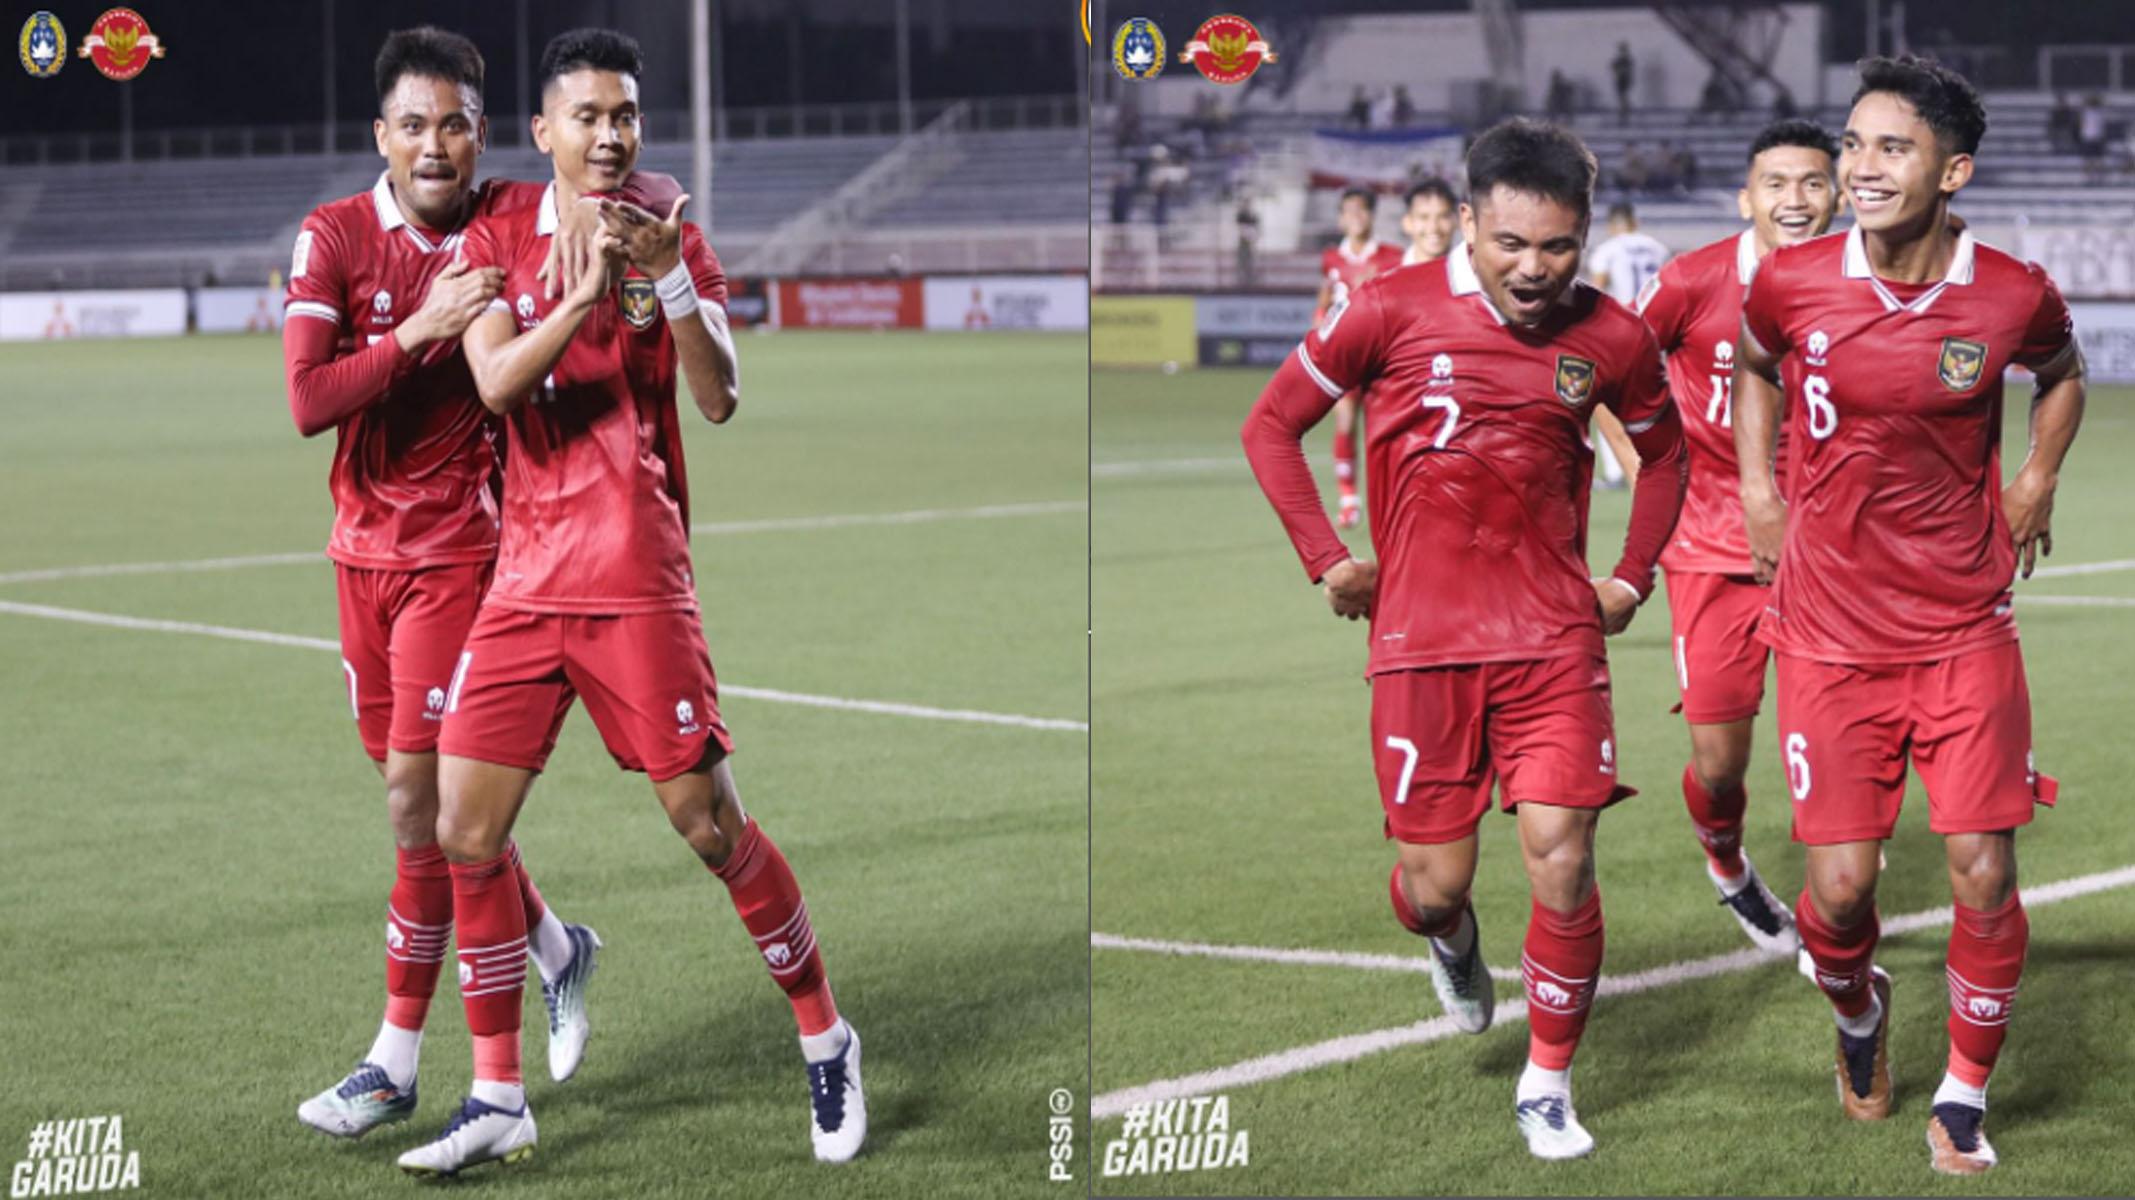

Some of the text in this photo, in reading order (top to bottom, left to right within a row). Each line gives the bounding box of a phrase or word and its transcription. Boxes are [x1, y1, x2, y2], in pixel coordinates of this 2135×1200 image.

[1422, 396, 1460, 449] 7
[1804, 374, 1838, 440] 6
[1386, 735, 1419, 804] 7
[1785, 732, 1812, 801] 6
